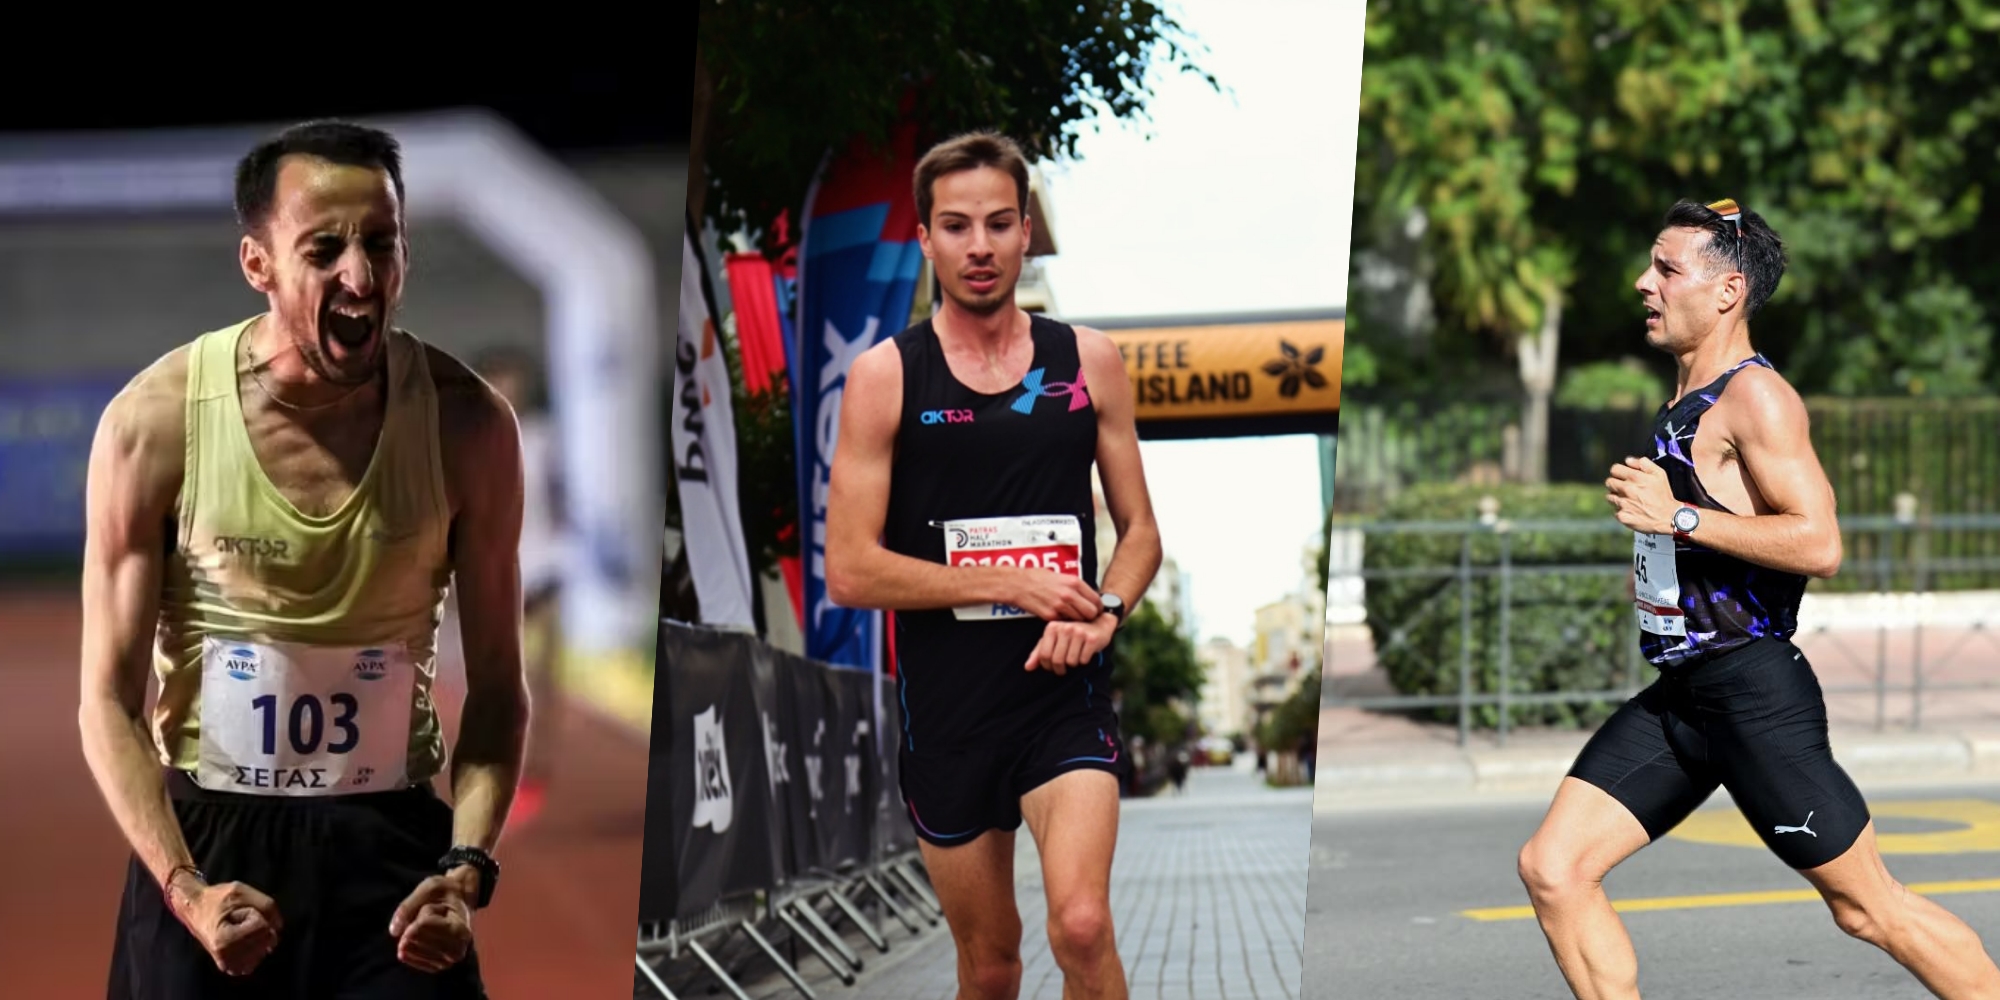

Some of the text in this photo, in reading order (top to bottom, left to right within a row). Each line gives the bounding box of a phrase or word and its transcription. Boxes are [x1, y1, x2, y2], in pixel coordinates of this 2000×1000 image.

[1137, 371, 1252, 404] ISLAND
[252, 693, 359, 755] 103
[235, 766, 327, 788] ΣΕΓΑΣ
